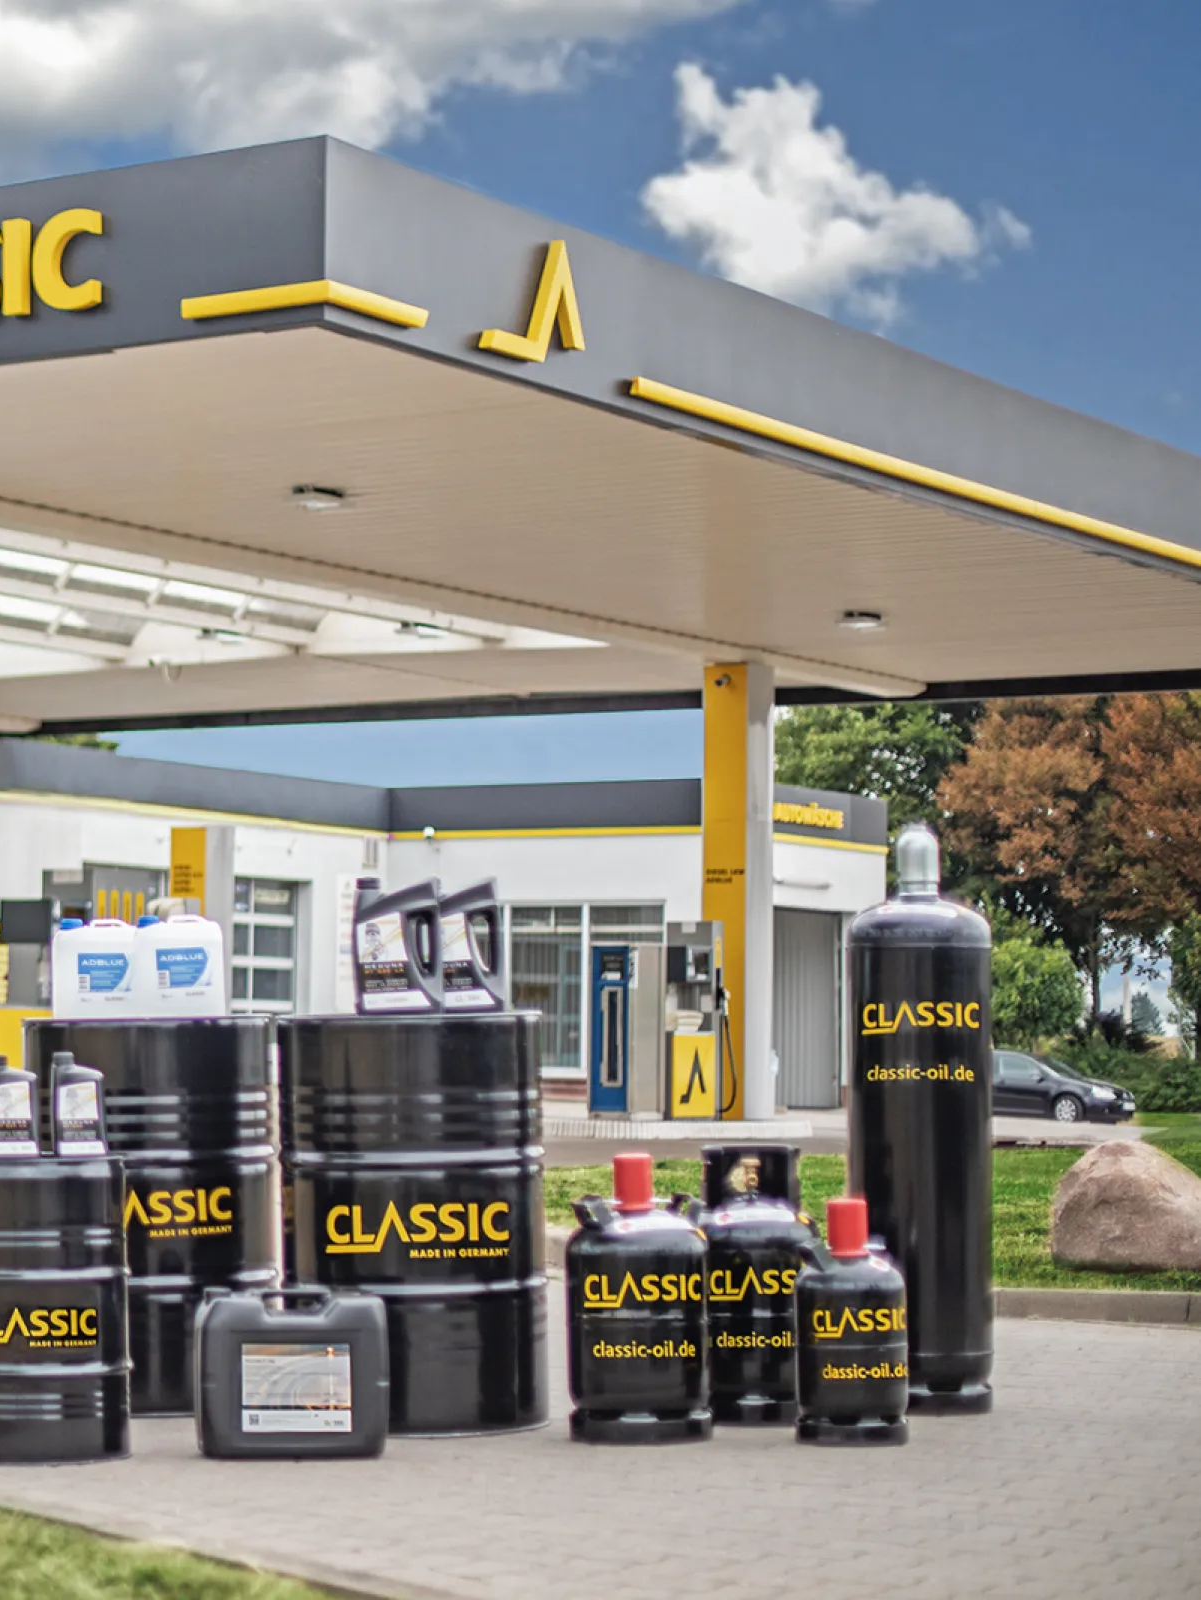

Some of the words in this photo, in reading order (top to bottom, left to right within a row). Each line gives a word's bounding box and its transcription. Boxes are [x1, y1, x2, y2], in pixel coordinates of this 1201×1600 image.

[81, 958, 125, 966] ADBLUE
[159, 952, 205, 962] ADBLUE
[861, 1000, 980, 1035] CLASSIC
[866, 1063, 975, 1082] classic-oil.de
[122, 1186, 233, 1233] ASSIC
[149, 1229, 175, 1238] MADE
[178, 1227, 189, 1237] IN
[191, 1225, 233, 1236] GERMANY
[325, 1200, 510, 1254] CLASSIC
[409, 1249, 441, 1259] MADE
[443, 1248, 457, 1258] IN
[458, 1247, 510, 1258] GERMANY
[583, 1270, 702, 1309] CLASSIC
[708, 1266, 798, 1301] CLASS
[812, 1306, 907, 1338] CLASSIC
[29, 1340, 51, 1348] MADE
[592, 1339, 697, 1359] classic-oil.de
[715, 1331, 796, 1348] classic-oil.
